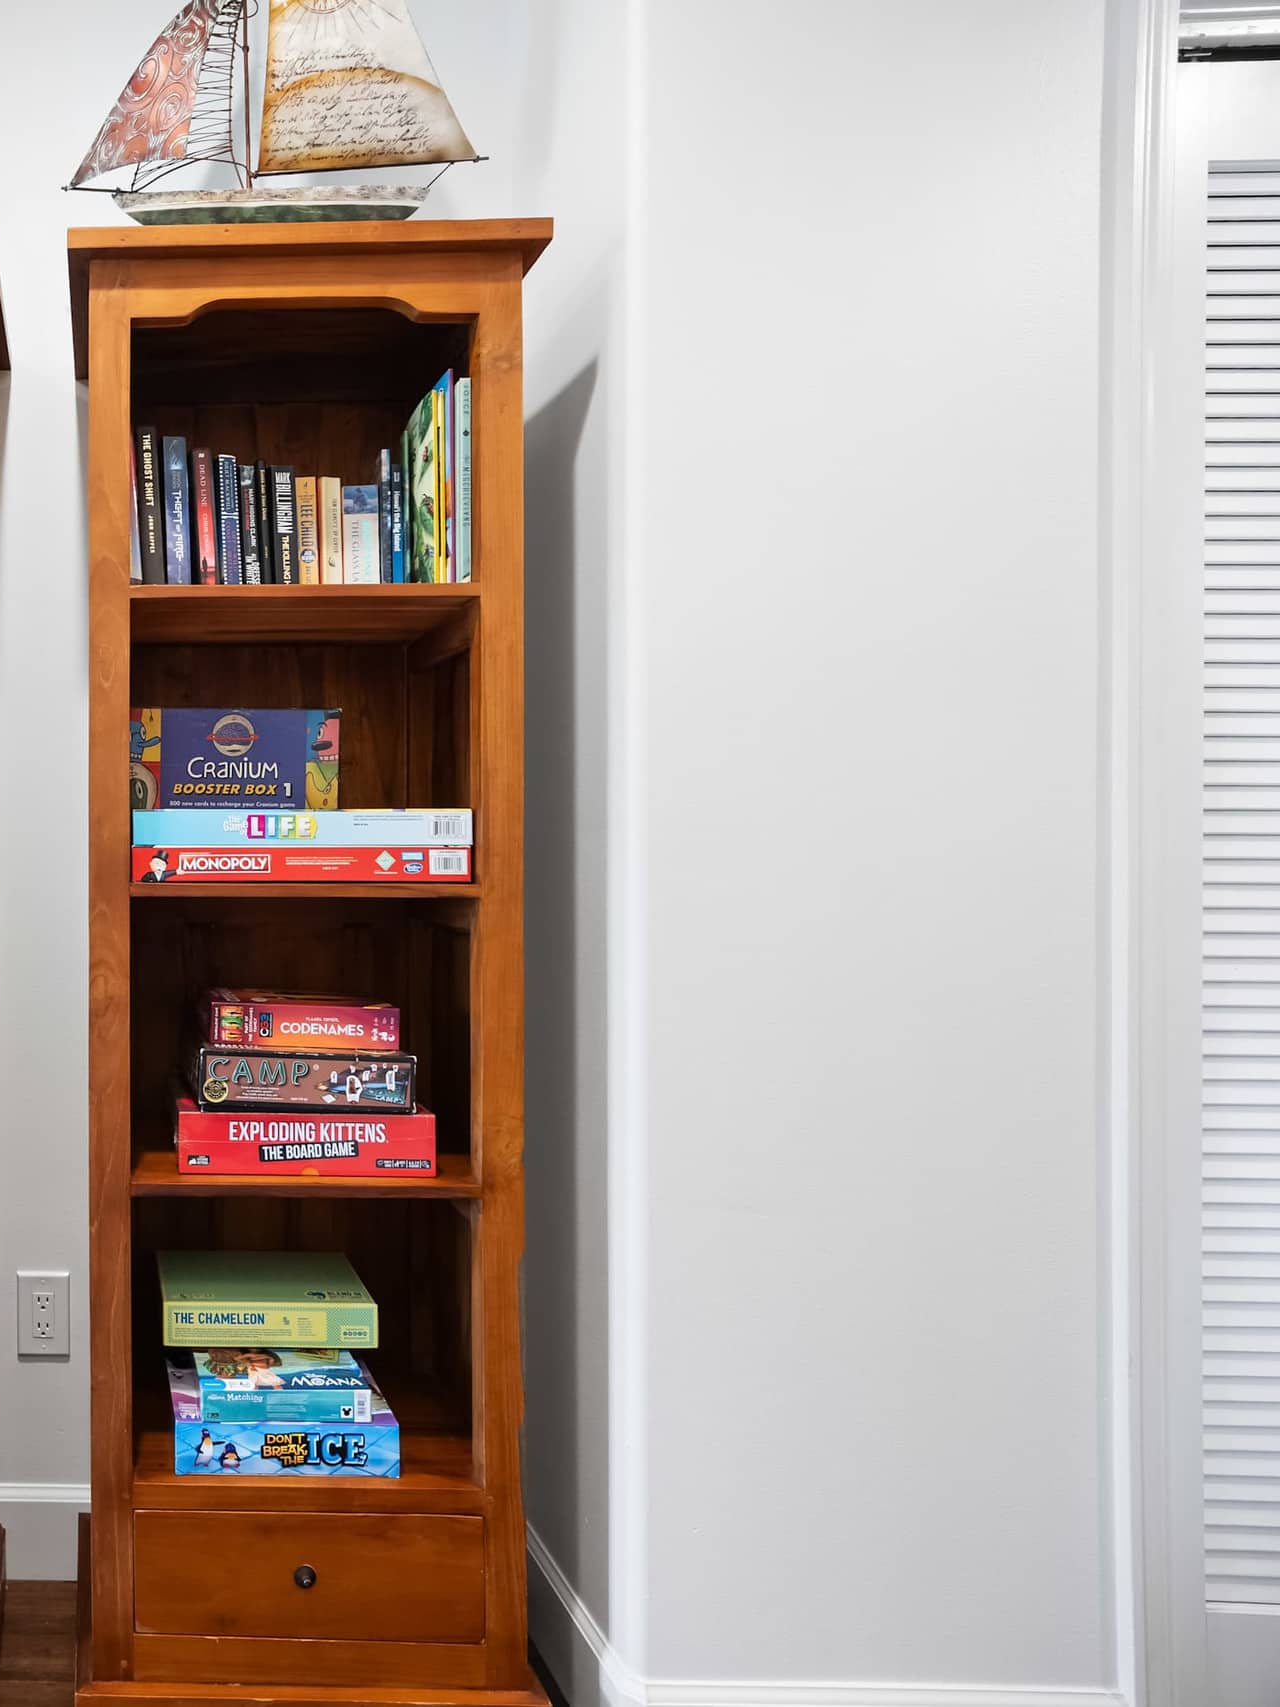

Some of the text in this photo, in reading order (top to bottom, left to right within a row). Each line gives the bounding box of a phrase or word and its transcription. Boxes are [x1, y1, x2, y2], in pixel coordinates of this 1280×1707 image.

[142, 434, 154, 507] THE GHOST SHIFT
[200, 489, 208, 508] LINE
[275, 484, 294, 534] BILLINGHAM
[300, 504, 313, 518] LEE
[300, 520, 314, 547] CHILD
[351, 521, 360, 539] THE
[282, 535, 290, 550] THE
[282, 550, 291, 580] KILLING
[173, 782, 292, 797] BOOSTER BOX 1
[250, 816, 312, 837] LIFE
[183, 856, 268, 870] MONOPOLY
[280, 1022, 365, 1037] CODENAMES
[208, 1057, 309, 1086] CAMP
[229, 1120, 386, 1143] EXPLODING KITTENS
[262, 1142, 356, 1161] THE BOARD GAME
[174, 1312, 265, 1326] THE CHAMELEON
[290, 1375, 363, 1387] MOANA
[226, 1393, 264, 1403] Matching
[266, 1434, 306, 1444] DON'T
[262, 1444, 308, 1456] BREAK
[306, 1434, 366, 1466] ICE
[280, 1456, 305, 1466] THE
